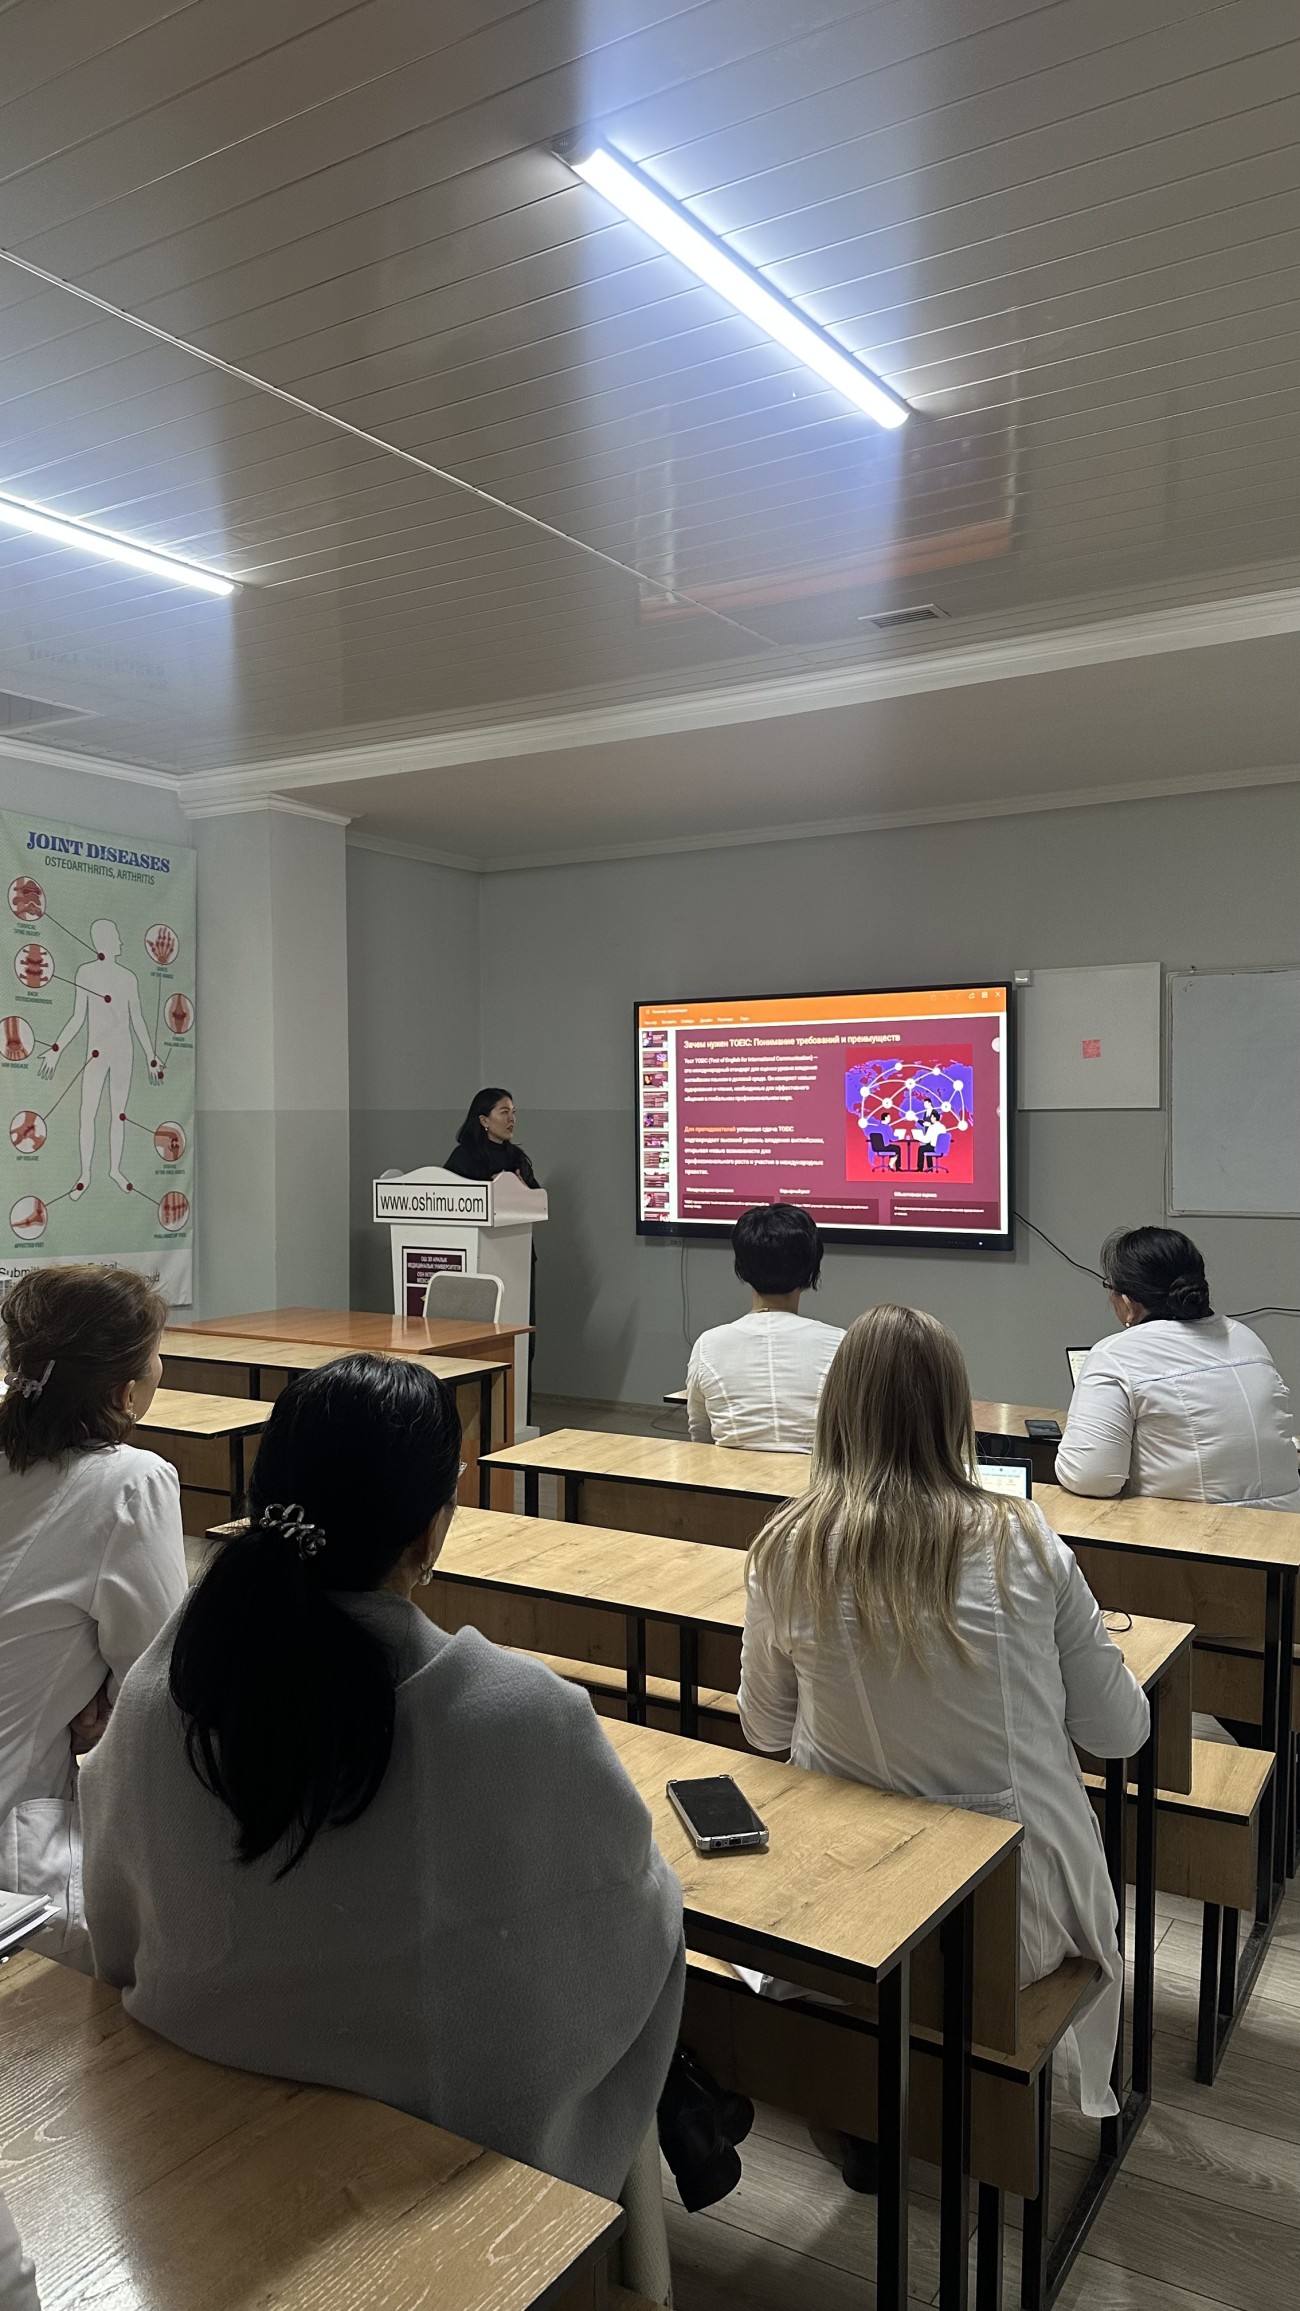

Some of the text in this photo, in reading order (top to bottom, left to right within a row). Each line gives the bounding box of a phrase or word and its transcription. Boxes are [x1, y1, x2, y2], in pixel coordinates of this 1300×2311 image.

[27, 831, 170, 873] JOINT DISEASES
[45, 855, 155, 885] OSTEOARTHRITIS, ARTHRITIS
[684, 1040, 706, 1048] Зачем
[706, 1040, 728, 1049] нужен
[729, 1038, 752, 1047] TOEIC:
[754, 1038, 795, 1046] Понимание
[796, 1035, 840, 1045] требований
[380, 1192, 484, 1213] www.oshimu.com
